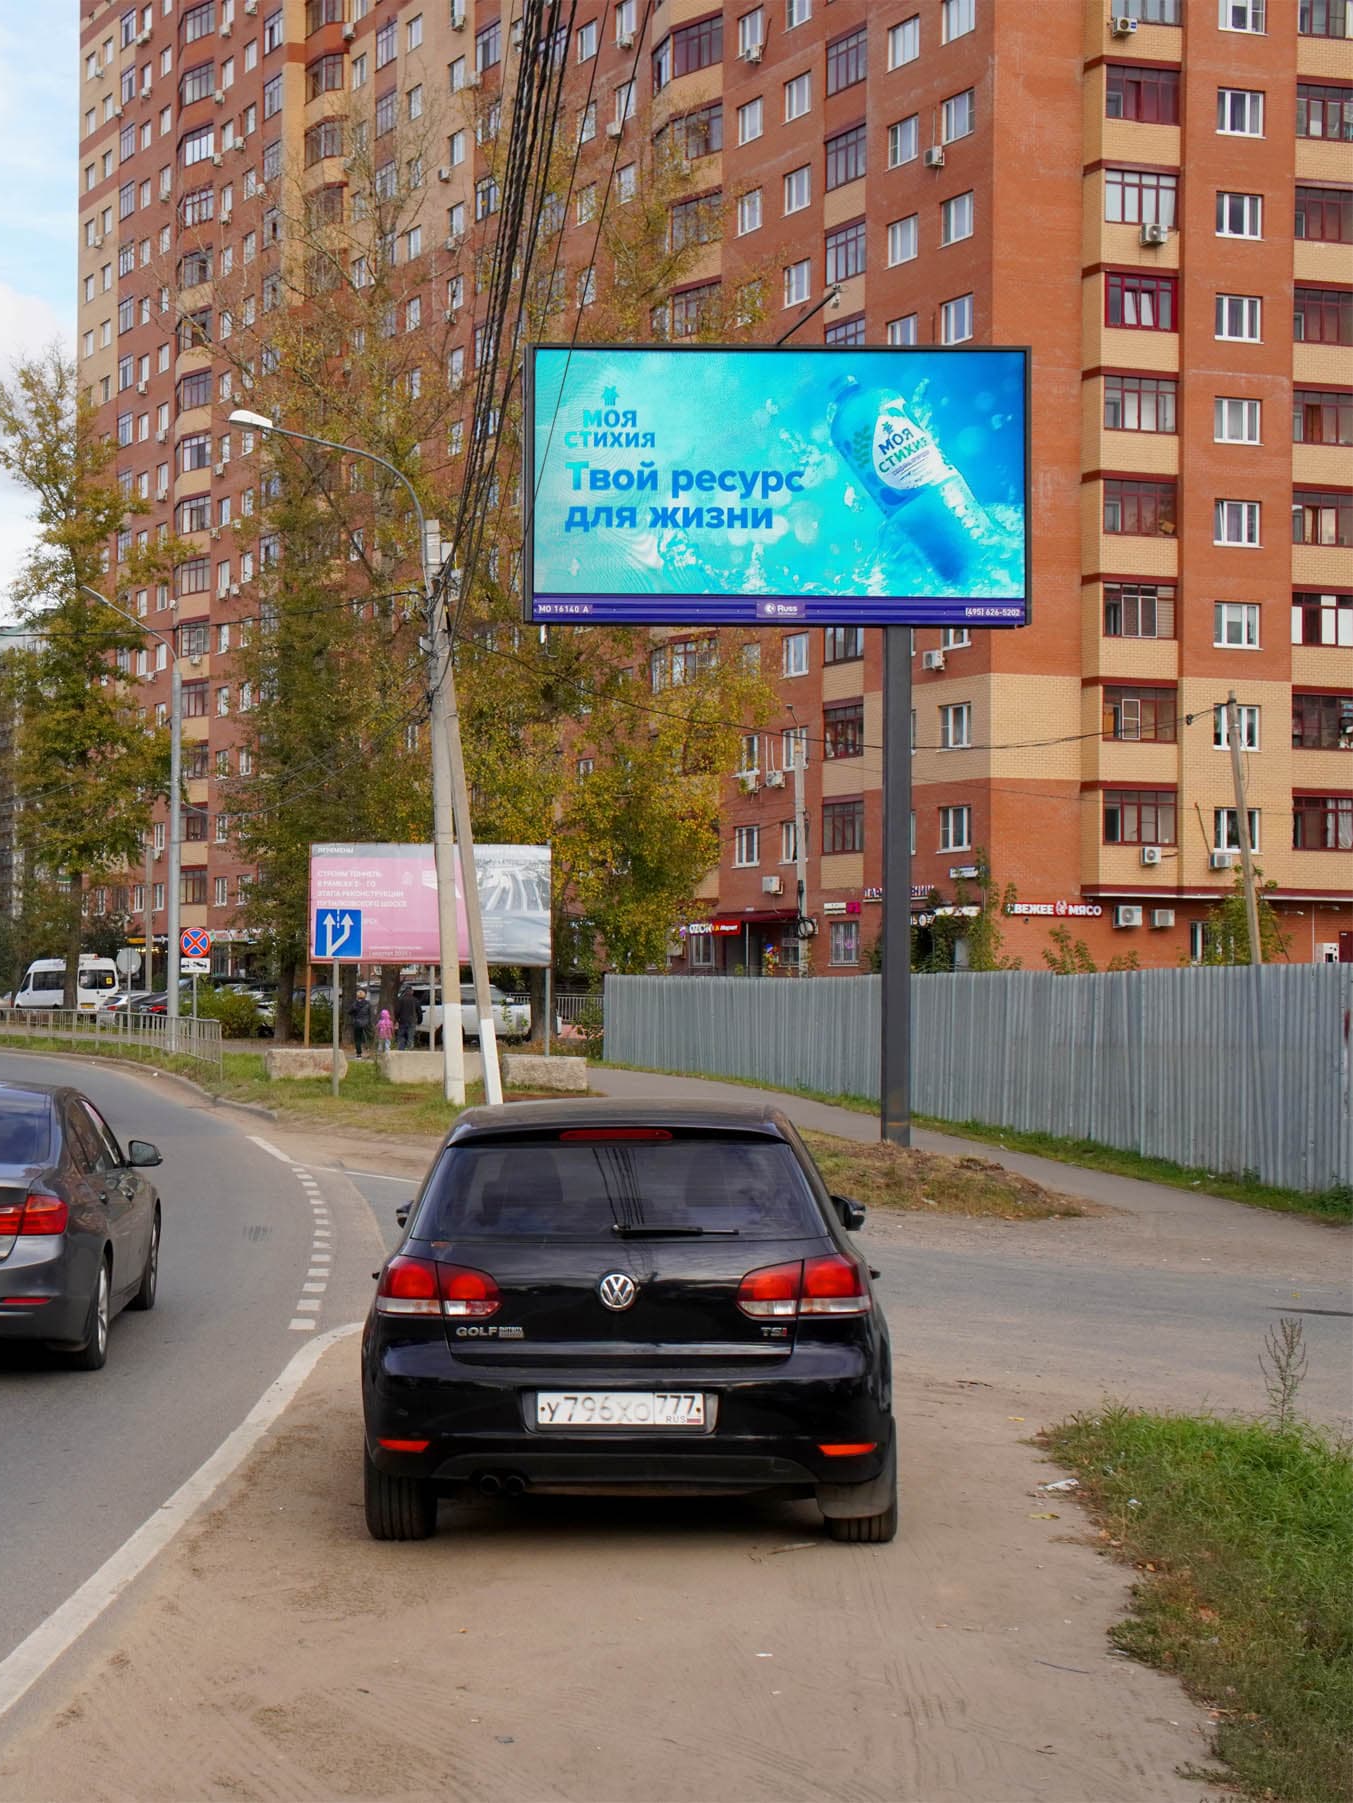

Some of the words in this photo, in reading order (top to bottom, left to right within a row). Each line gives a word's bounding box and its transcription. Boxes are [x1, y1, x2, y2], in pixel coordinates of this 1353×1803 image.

[583, 409, 637, 428] МОЯ
[564, 431, 656, 448] СТИХИЯ
[877, 427, 914, 455] МОЯ
[565, 460, 659, 491] Твой
[671, 469, 805, 500] ресурс
[564, 506, 637, 533] для
[648, 506, 774, 529] жизни
[777, 604, 798, 612] Russ
[1068, 904, 1103, 916] МЯСО
[455, 1326, 497, 1337] GOLF
[547, 1396, 651, 1422] У796ХО
[656, 1394, 696, 1415] 777
[665, 1415, 687, 1424] RUS
